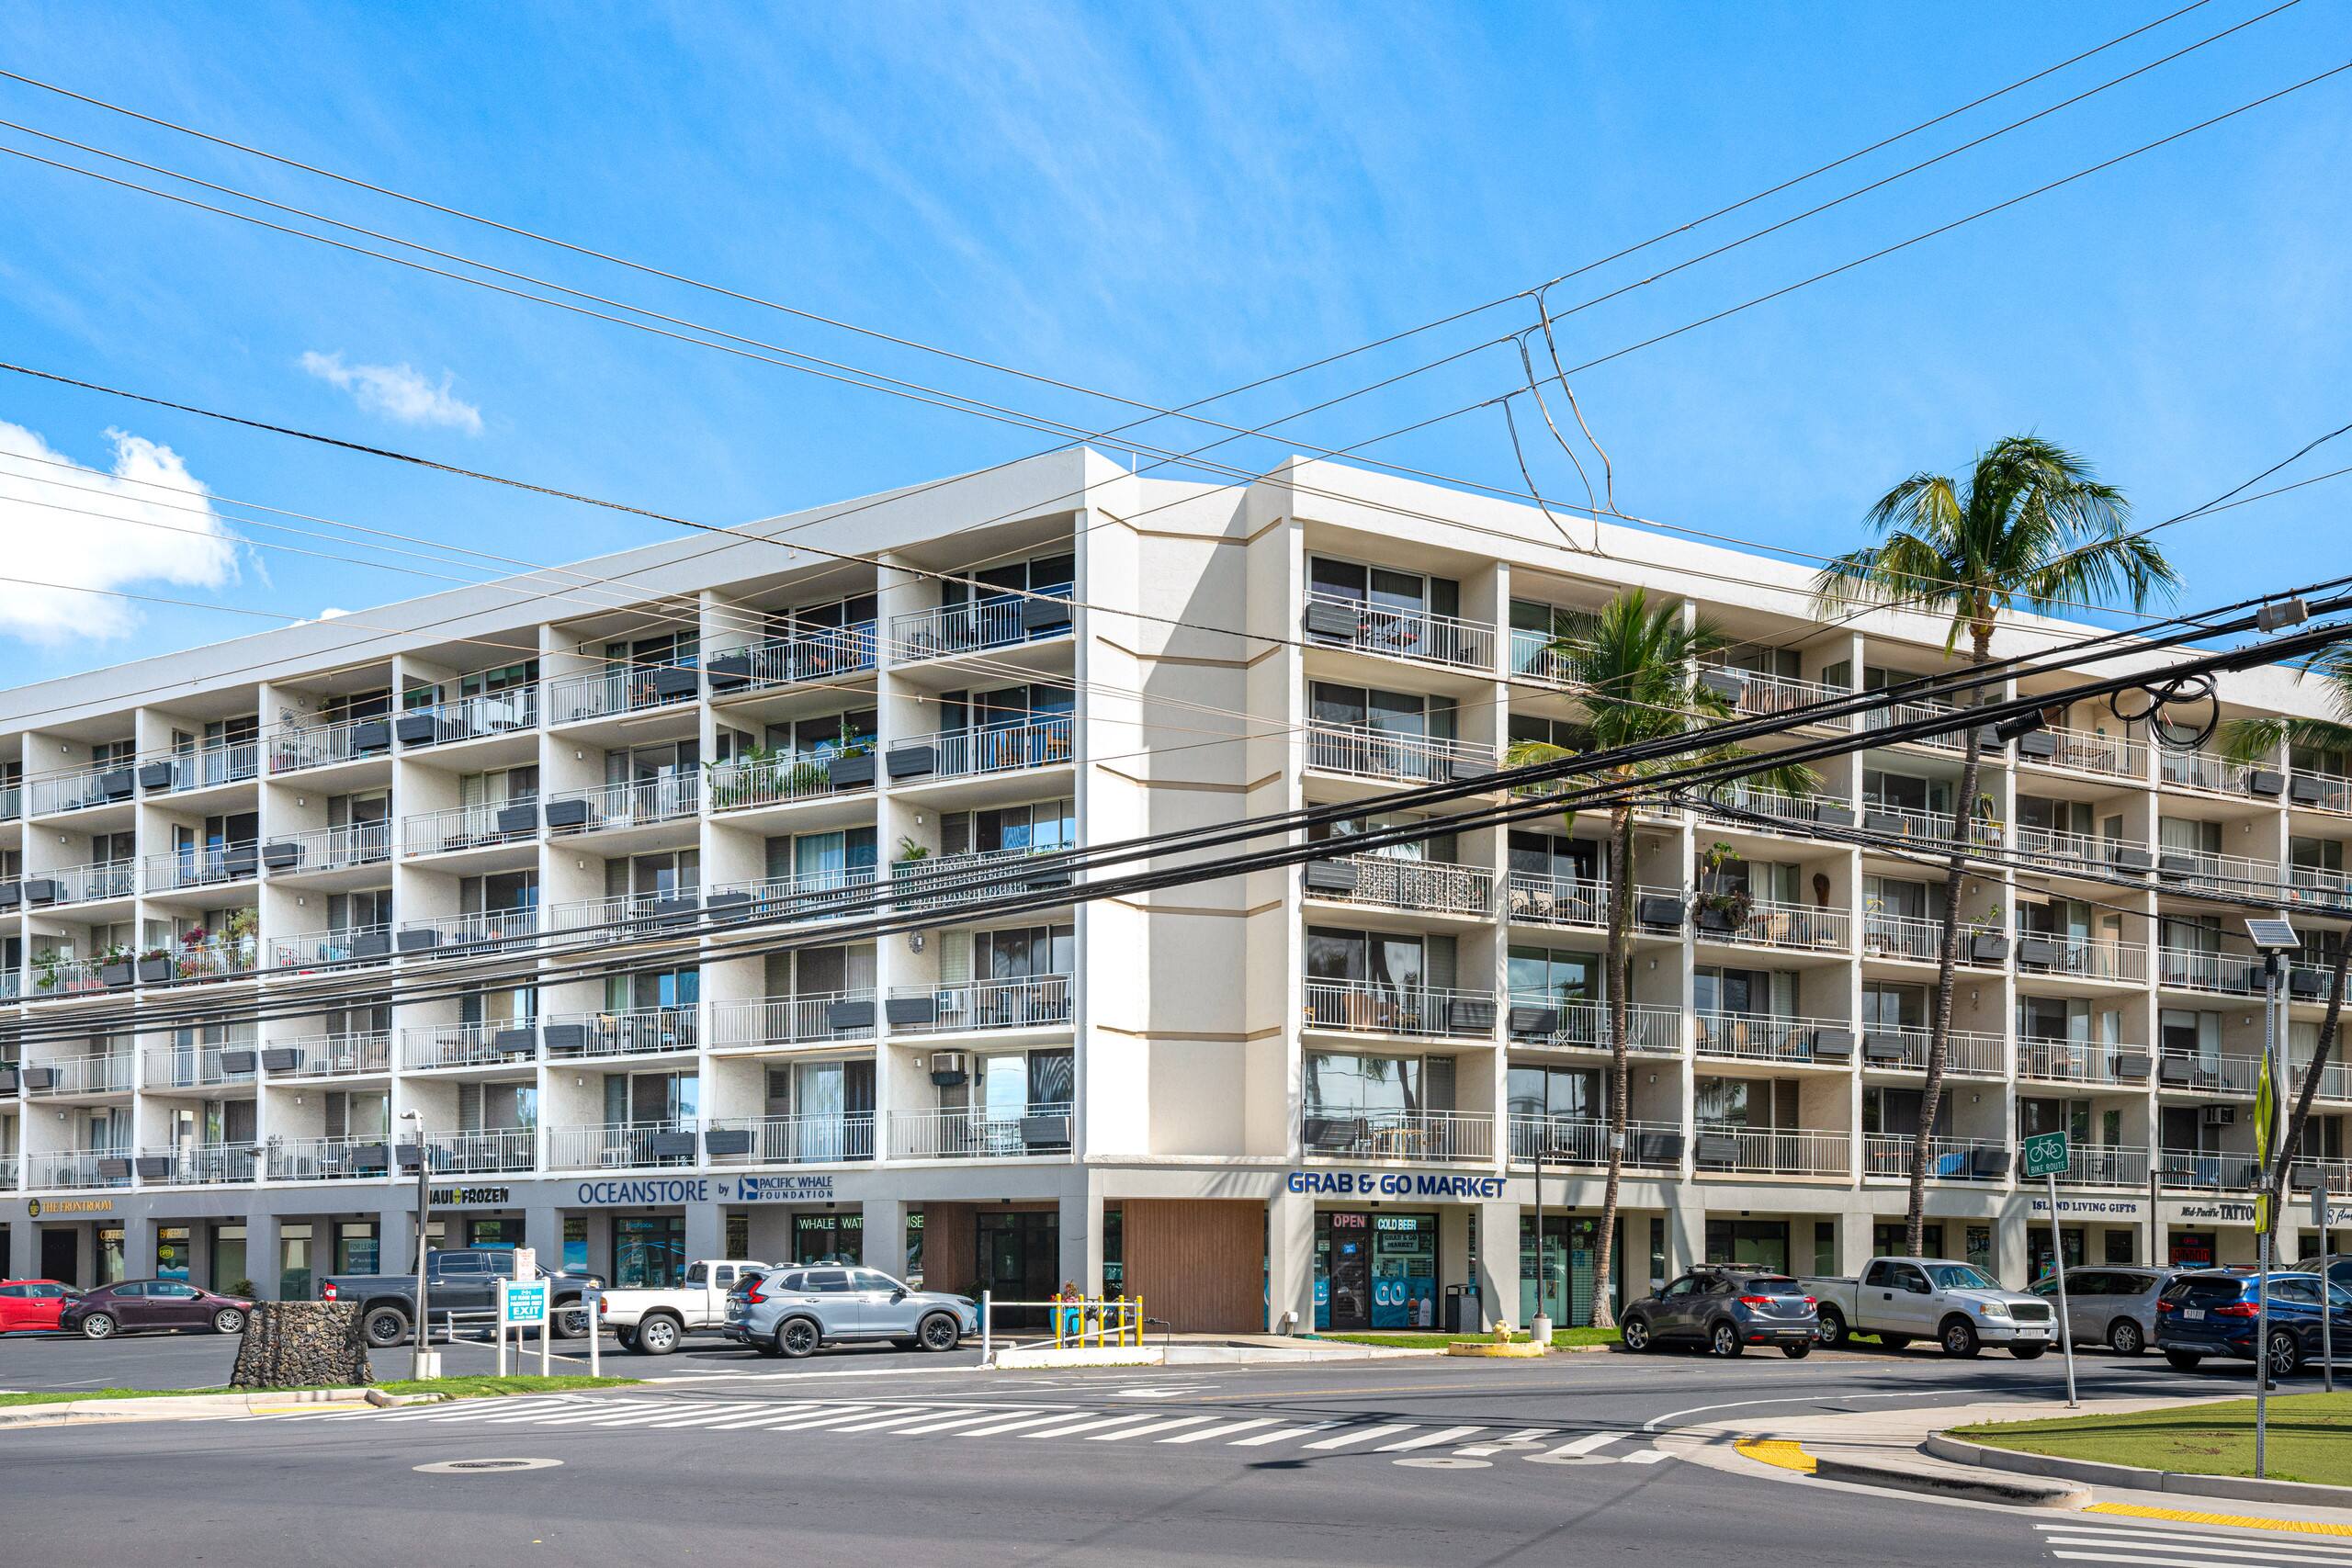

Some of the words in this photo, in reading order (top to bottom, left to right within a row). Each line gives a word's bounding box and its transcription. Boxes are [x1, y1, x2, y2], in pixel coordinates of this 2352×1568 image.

[2030, 1165, 2044, 1174] BIKE
[2046, 1161, 2065, 1171] ROUTE
[759, 1177, 796, 1190] PACIFIC
[797, 1176, 833, 1188] WHALE
[1288, 1172, 1353, 1193] GRAB
[1359, 1174, 1375, 1193] &
[1380, 1175, 1412, 1194] GO
[1417, 1176, 1507, 1198] MARKET
[461, 1187, 509, 1204] FROZEN
[578, 1180, 708, 1204] OCEANSTORE
[718, 1183, 729, 1197] by
[759, 1190, 833, 1200] FOUNDATION
[42, 1201, 59, 1213] THE
[60, 1200, 113, 1213] FRONTROOM
[2032, 1201, 2069, 1211] ISLND
[2072, 1201, 2106, 1212] LIVING
[2109, 1203, 2137, 1213] GIFTS
[799, 1218, 835, 1229] WHALE
[842, 1217, 864, 1229] WAT
[1333, 1215, 1365, 1228] OPEN
[1377, 1218, 1396, 1230] COLD
[1397, 1219, 1417, 1230] BEER
[1375, 1281, 1406, 1306] GO
[513, 1306, 540, 1315] EXIT
